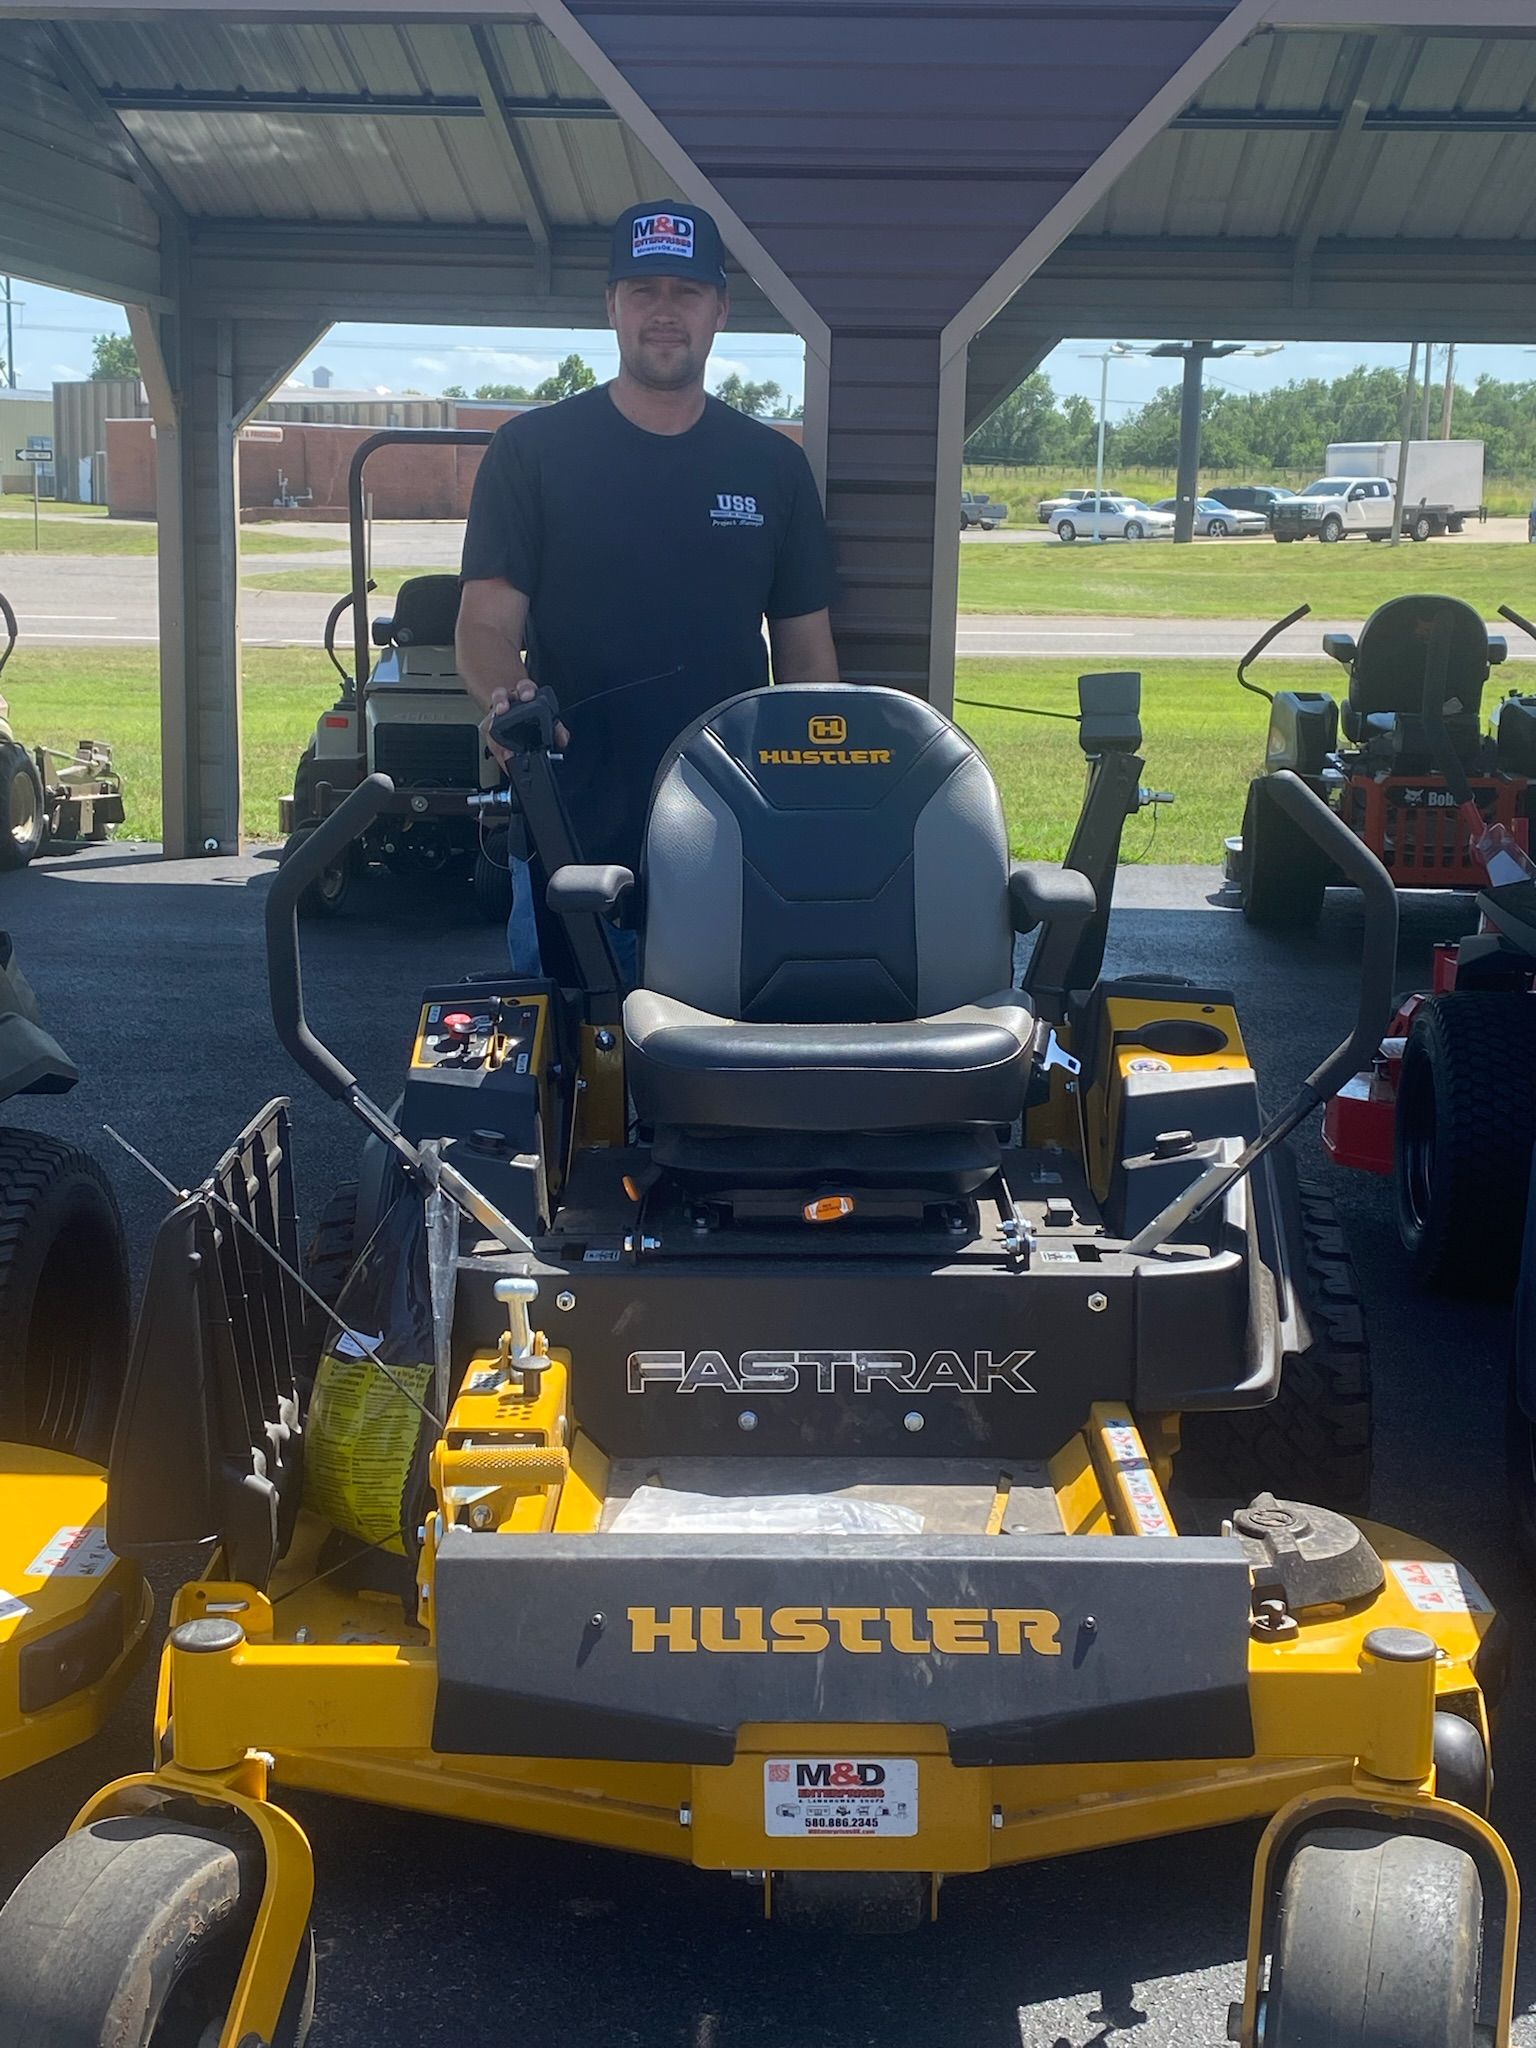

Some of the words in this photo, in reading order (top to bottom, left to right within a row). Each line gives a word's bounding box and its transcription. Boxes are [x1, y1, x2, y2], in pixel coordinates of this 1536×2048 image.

[634, 216, 691, 239] M&D
[634, 236, 692, 248] ENTERPRISES
[716, 494, 757, 513] USS
[759, 749, 891, 765] HUSTLER
[626, 1350, 1038, 1394] FASTRAK
[627, 1606, 1062, 1656] HUSTLER
[796, 1763, 885, 1787] M&D
[798, 1788, 885, 1798] ENTERPRISES
[805, 1818, 879, 1828] 580.886.2345
